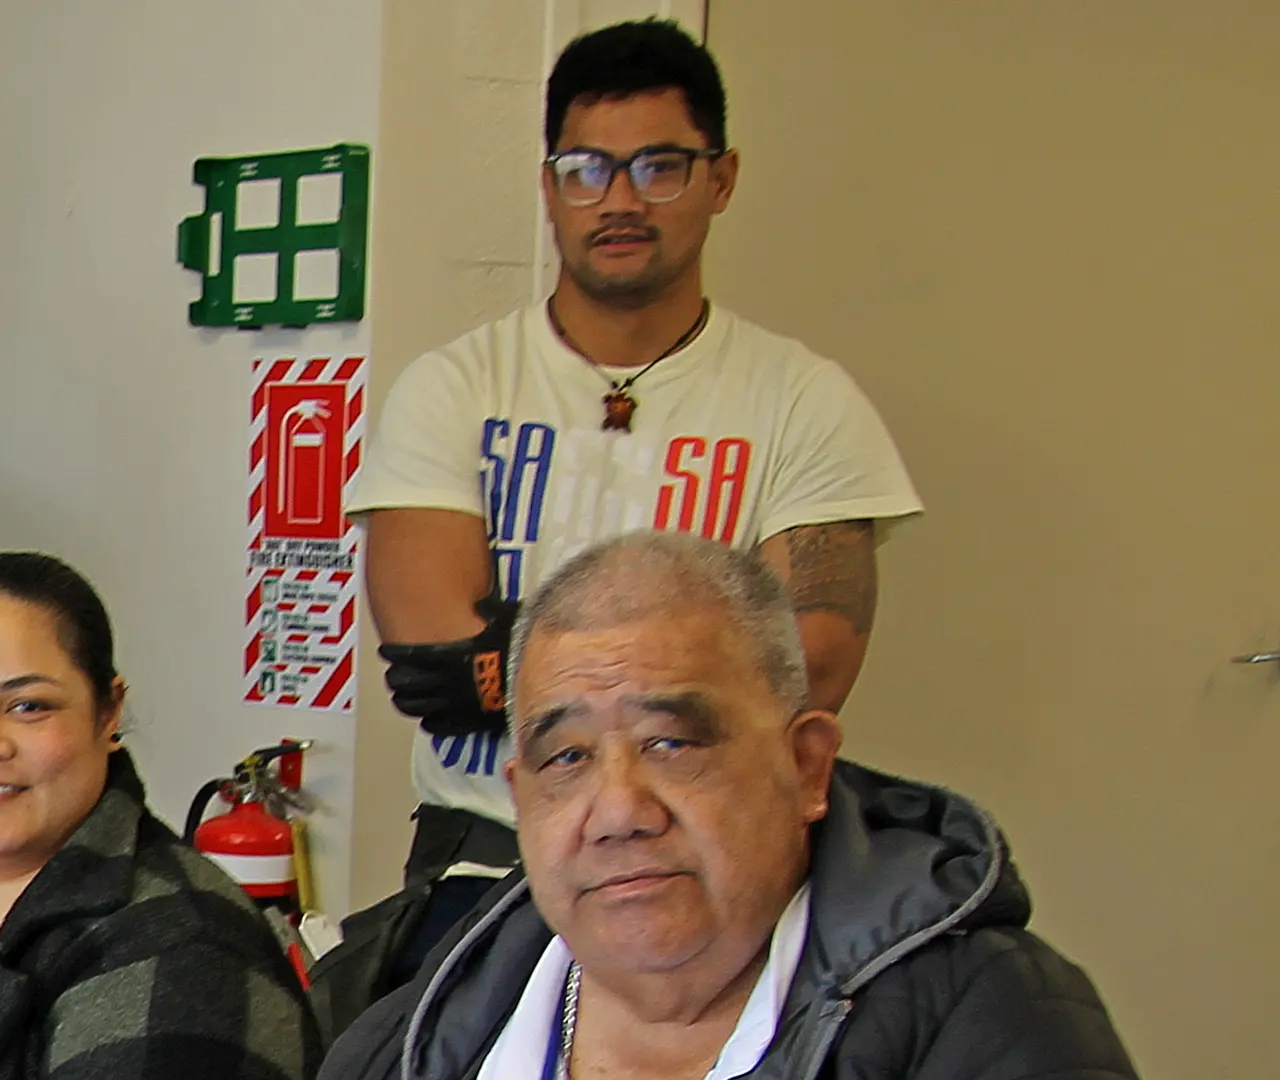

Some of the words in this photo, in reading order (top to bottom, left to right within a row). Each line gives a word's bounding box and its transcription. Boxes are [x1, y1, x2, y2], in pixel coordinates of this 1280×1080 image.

[479, 419, 556, 542] SA
[653, 436, 751, 545] SA
[249, 551, 273, 567] FIRE
